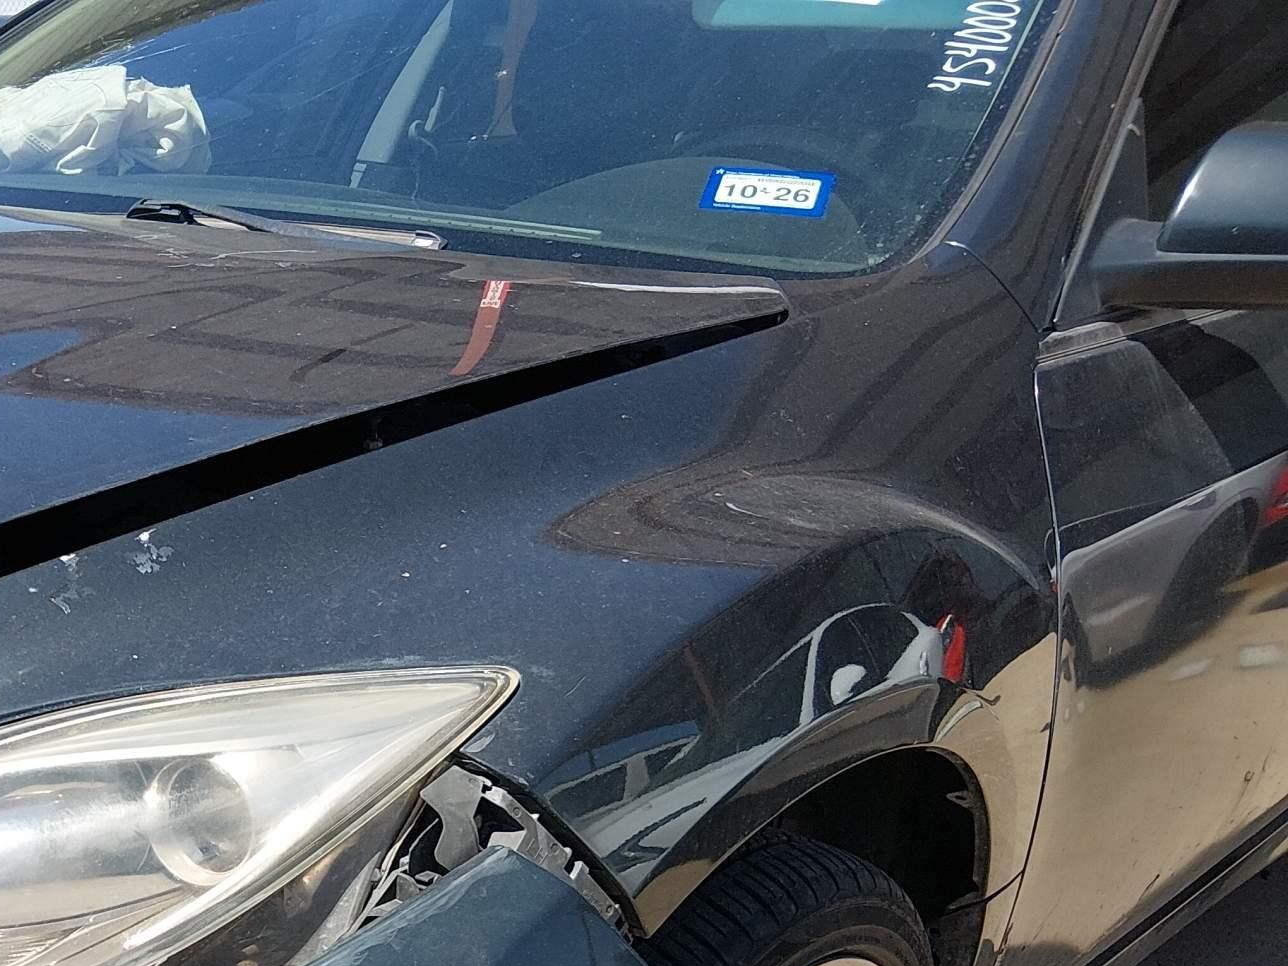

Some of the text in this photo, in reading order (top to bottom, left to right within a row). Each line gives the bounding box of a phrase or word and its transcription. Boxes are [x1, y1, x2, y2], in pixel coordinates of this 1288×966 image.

[927, 0, 1021, 92] 454000
[724, 183, 811, 203] 10 26
